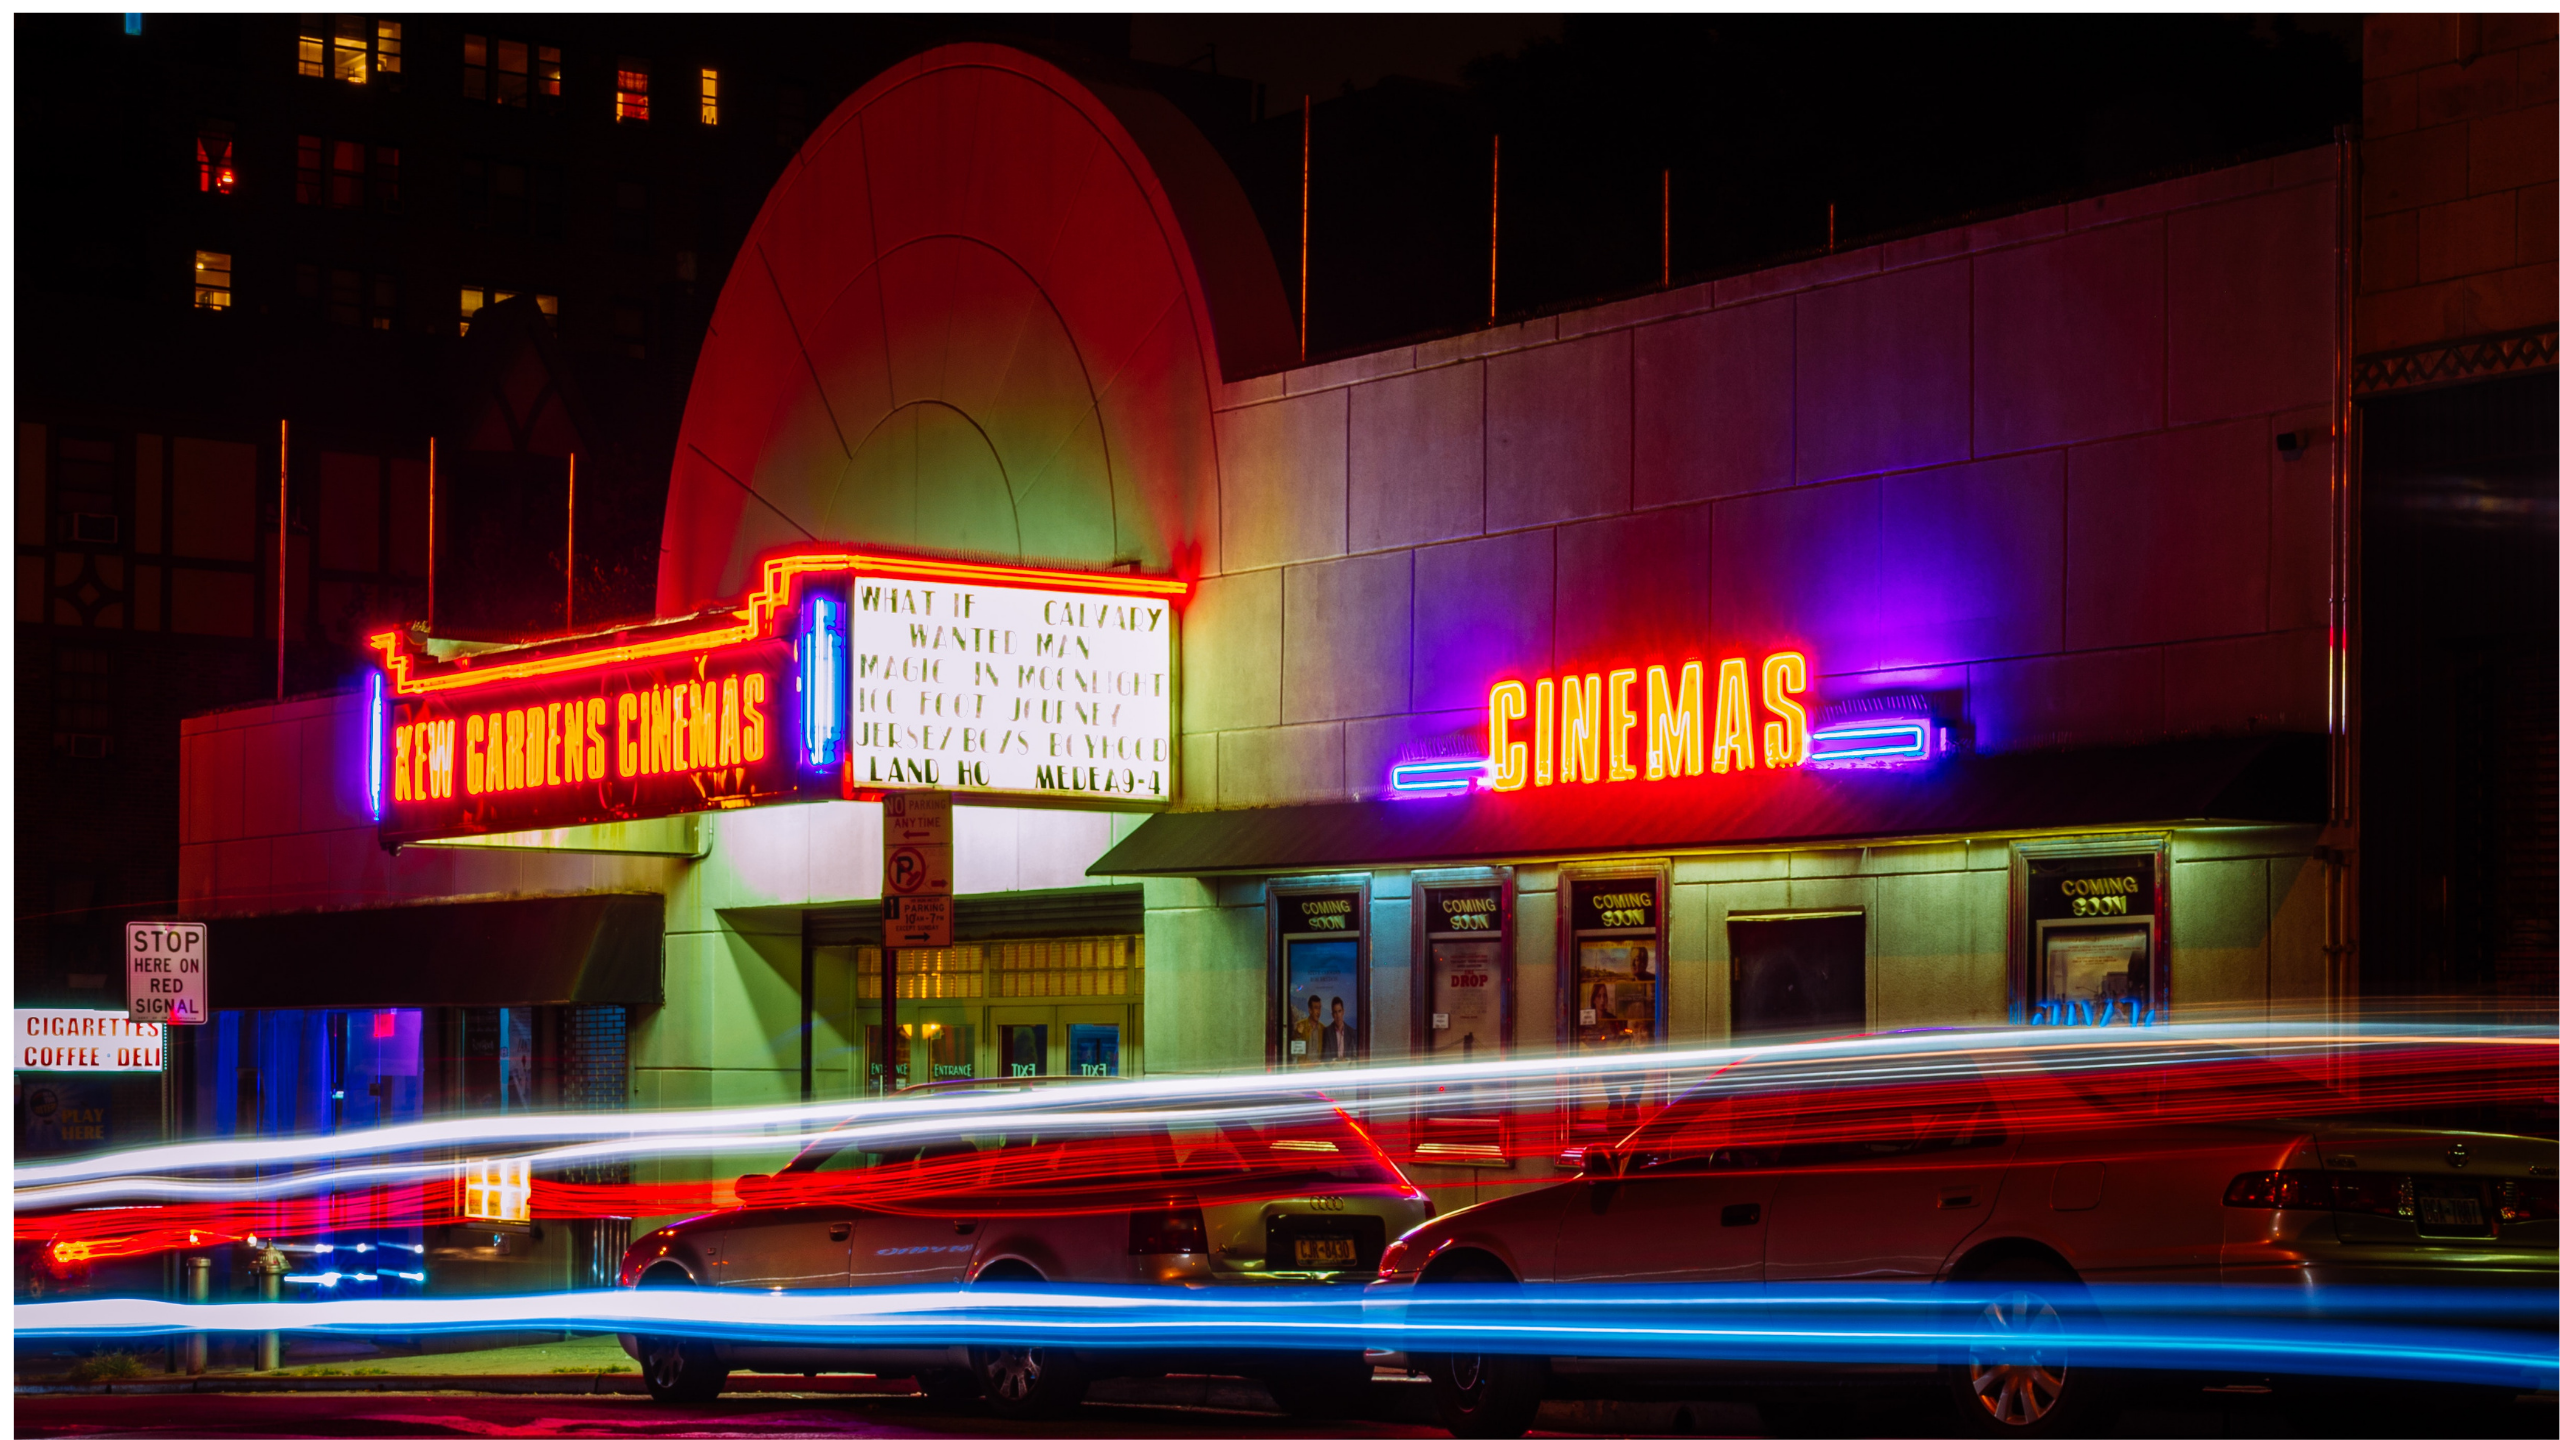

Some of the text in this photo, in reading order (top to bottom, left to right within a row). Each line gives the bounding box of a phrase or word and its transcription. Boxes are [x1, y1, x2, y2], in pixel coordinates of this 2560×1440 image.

[861, 586, 975, 618] WHAT IF
[1044, 600, 1162, 632] CALVARY
[909, 623, 1091, 660] WANTED MAN
[859, 654, 1166, 697] MAGIC IN MOONLIGHT
[919, 690, 987, 719] FOOT
[1008, 696, 1122, 728] JOURNEY
[1489, 651, 1808, 793] CINEMAS
[394, 672, 766, 802] KEW GARDENS CINEMAS
[856, 721, 1168, 763] JERSEY BOYS BOYHOOD
[870, 756, 940, 784] LAND
[957, 759, 991, 786] HO
[885, 796, 946, 815] NO PARKING
[2061, 876, 2139, 897] COMING
[904, 903, 945, 912] PARKING
[1301, 899, 1351, 916] COMING
[1442, 898, 1496, 914] COMING
[1592, 892, 1652, 909] COMING
[2071, 895, 2128, 917] SOON
[1308, 914, 1346, 931] SOON
[1450, 913, 1490, 931] SOON
[1601, 908, 1645, 927] SOON
[134, 930, 200, 953] STOP
[134, 958, 200, 974] HERE ON
[150, 978, 183, 993] RED
[1451, 974, 1488, 987] DROP
[135, 998, 199, 1014] SIGNAL
[26, 1016, 159, 1037] CIGARETTES
[24, 1046, 160, 1067] COFFEE DELI
[871, 1062, 908, 1076] ENTNCE
[934, 1063, 972, 1077] ENTRANCE
[61, 1108, 104, 1124] PLAY
[61, 1125, 104, 1141] HERE
